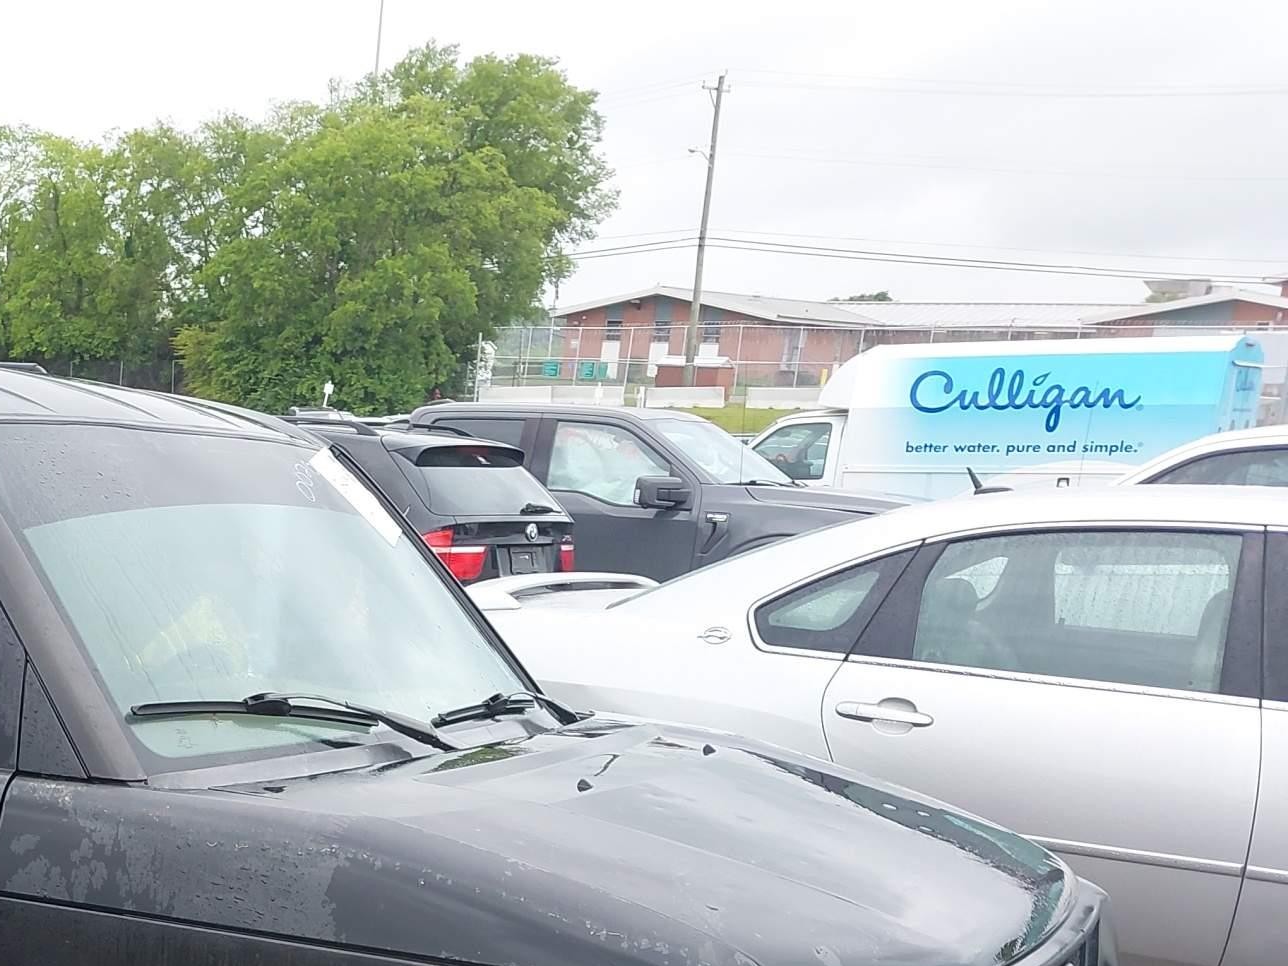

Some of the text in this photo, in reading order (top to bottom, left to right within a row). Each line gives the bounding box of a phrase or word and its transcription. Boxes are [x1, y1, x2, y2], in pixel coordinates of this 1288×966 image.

[910, 367, 1141, 432] Culligan
[905, 440, 1138, 456] better water. pure and simple.
